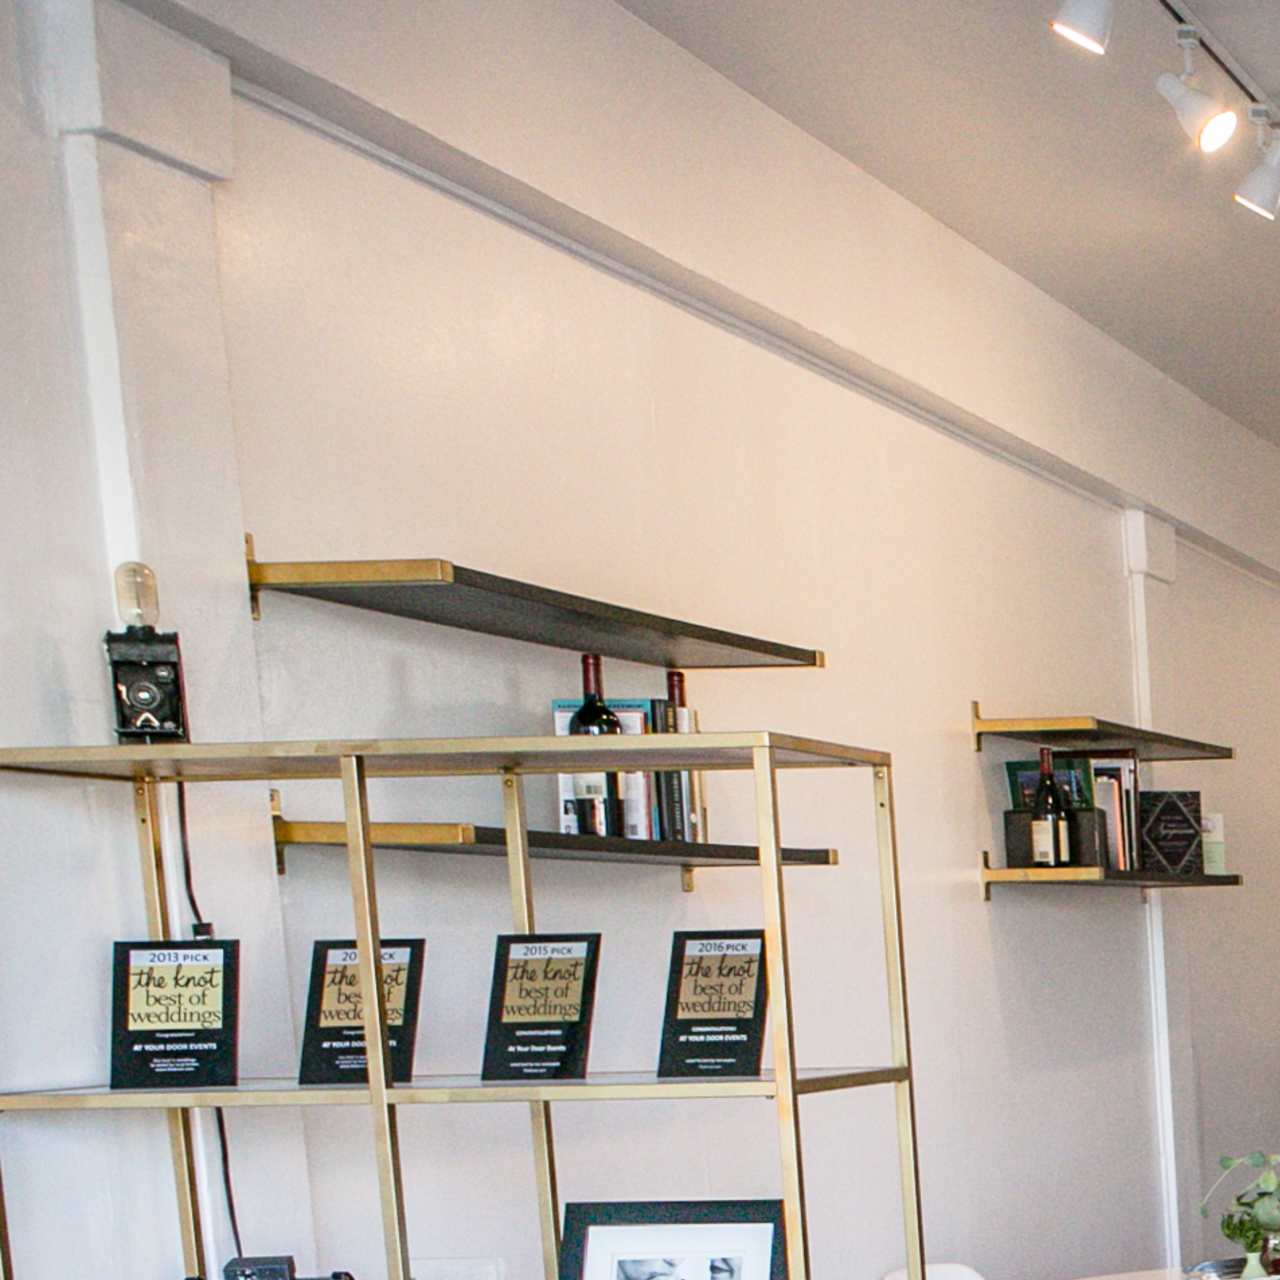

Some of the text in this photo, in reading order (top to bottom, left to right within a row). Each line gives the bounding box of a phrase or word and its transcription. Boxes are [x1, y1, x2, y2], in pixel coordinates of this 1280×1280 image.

[149, 952, 210, 963] 2013 PICK
[523, 946, 573, 956] 2015 PICK
[698, 942, 749, 953] 2016 PICK
[129, 963, 222, 990] the knot
[326, 965, 359, 988] the
[508, 957, 583, 982] the knot
[684, 953, 759, 979] the knot
[145, 988, 210, 1007] best of
[518, 979, 573, 1000] best of
[693, 977, 746, 996] best of
[129, 1005, 222, 1029] weddings
[504, 999, 580, 1021] weddings
[679, 995, 755, 1018] weddings
